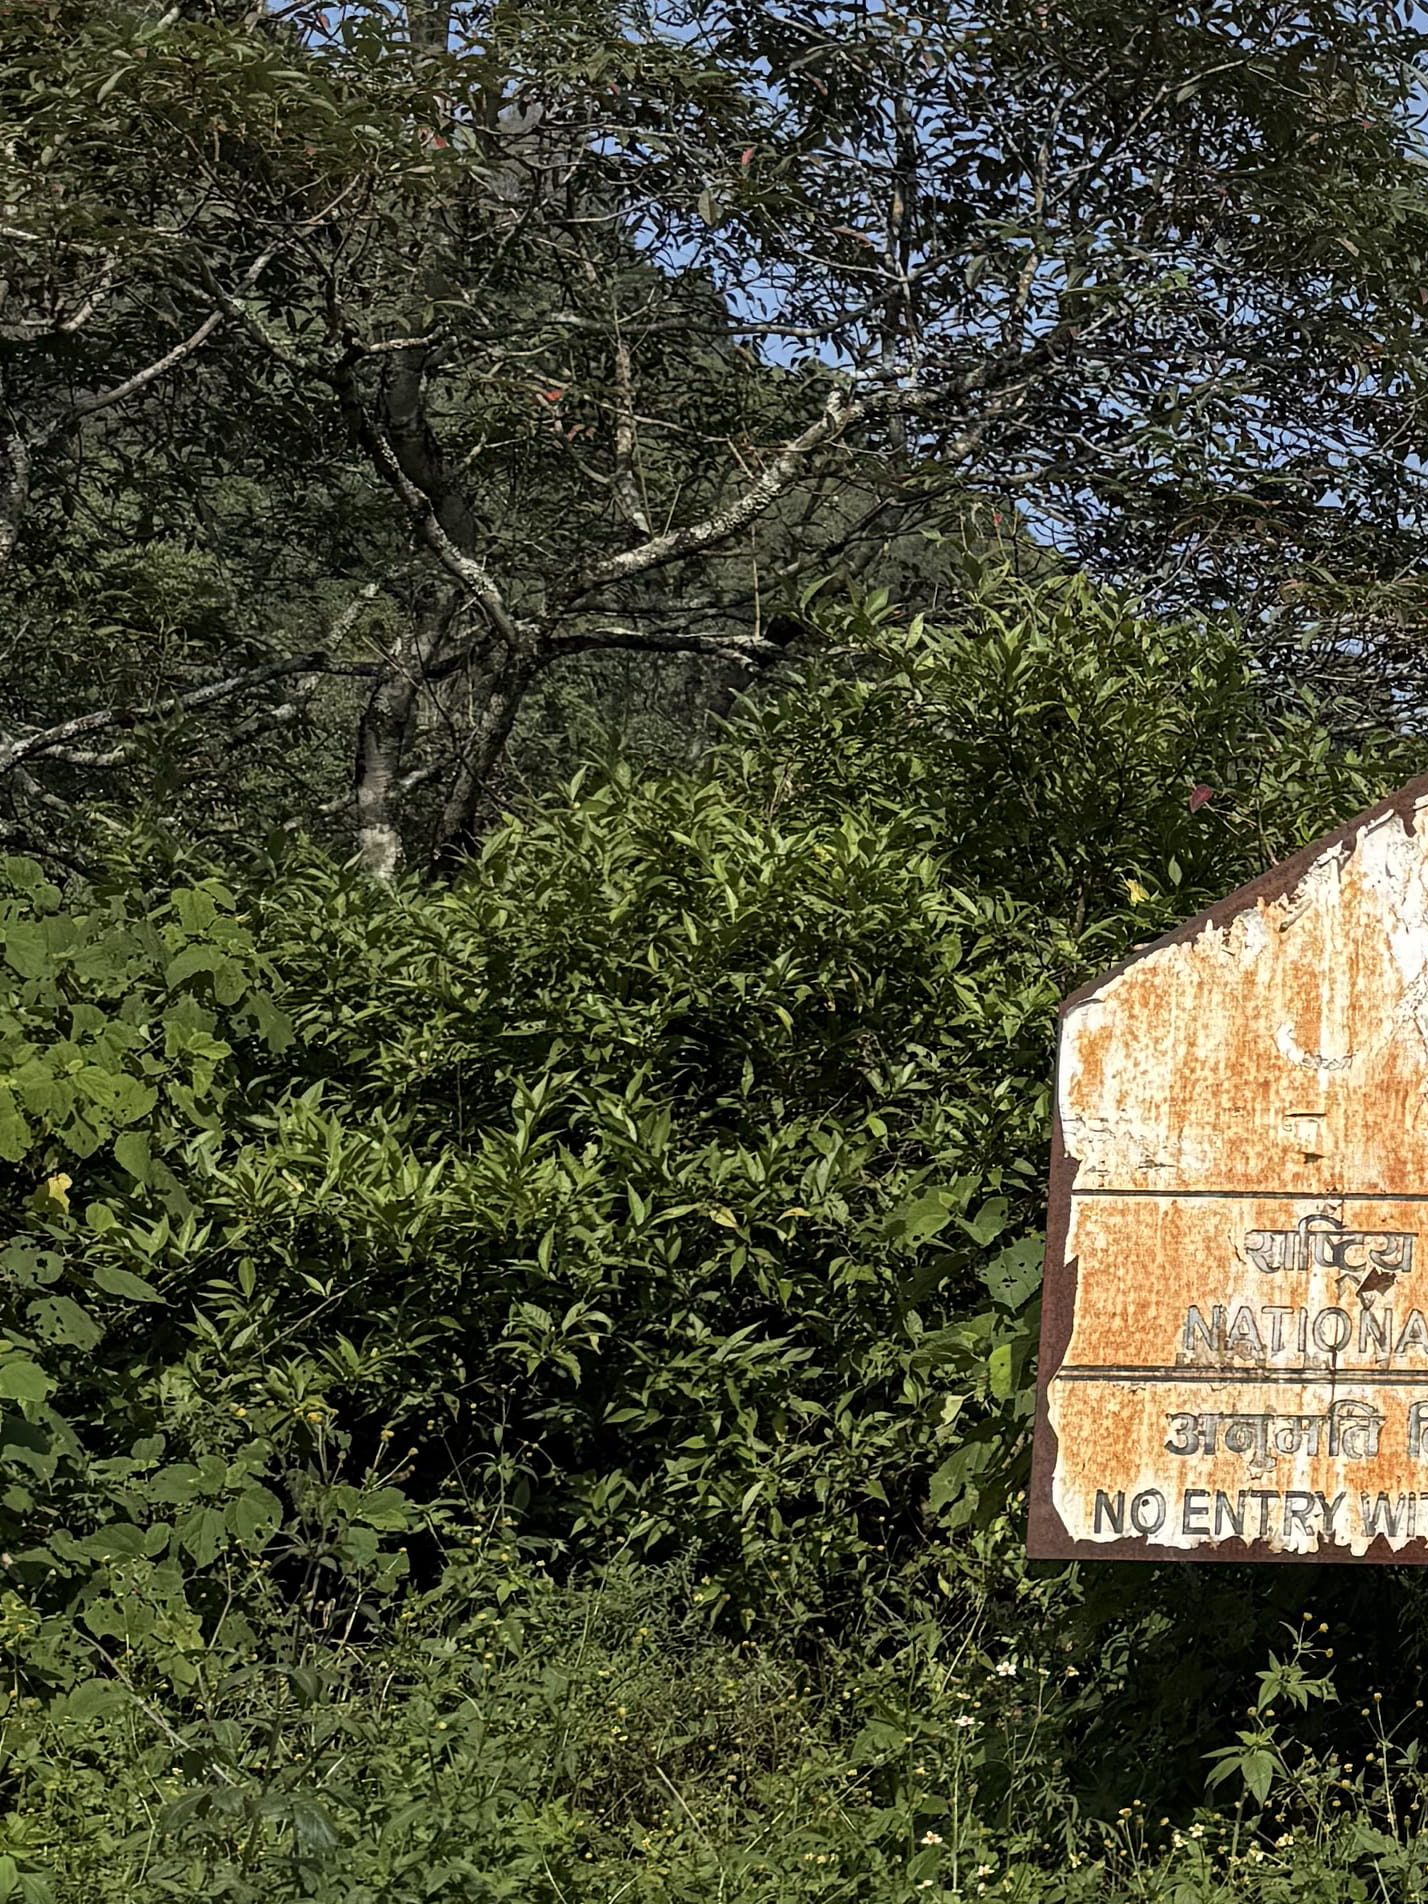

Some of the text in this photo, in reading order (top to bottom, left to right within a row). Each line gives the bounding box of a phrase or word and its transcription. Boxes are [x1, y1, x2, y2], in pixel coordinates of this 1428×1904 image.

[1164, 1399, 1386, 1478] अनुमति
[1093, 1488, 1167, 1536] NO
[1182, 1488, 1347, 1537] ENTRY
